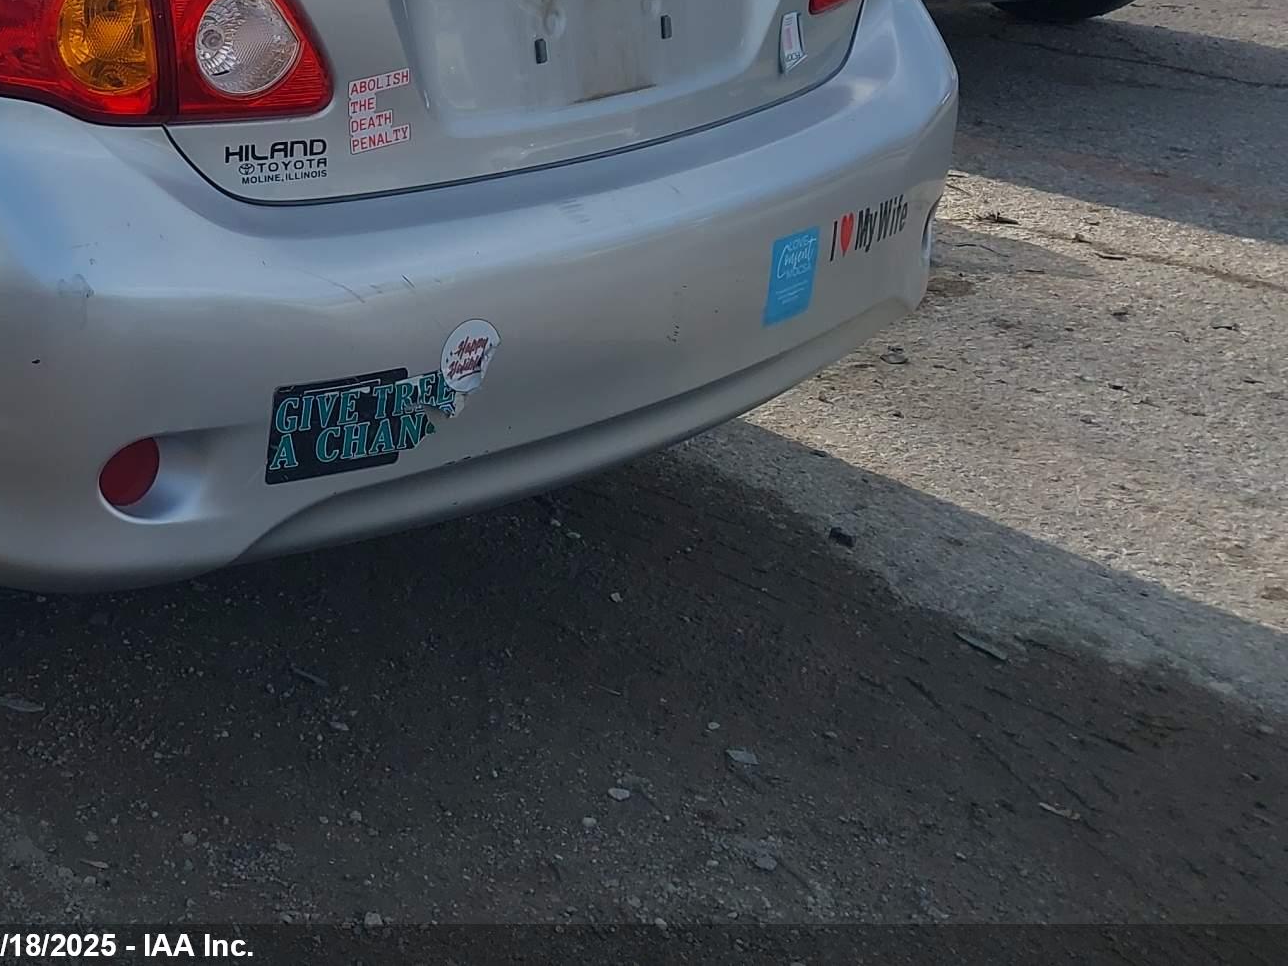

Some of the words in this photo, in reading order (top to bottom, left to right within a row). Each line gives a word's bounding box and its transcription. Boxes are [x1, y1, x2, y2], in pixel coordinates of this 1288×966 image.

[350, 70, 409, 96] ABOLISH
[350, 97, 376, 114] THE
[351, 112, 392, 133] DEATH
[225, 138, 327, 164] HILAND
[352, 126, 409, 153] PENALTY
[257, 158, 327, 173] TOYOTA
[829, 220, 838, 262] I
[854, 207, 878, 253] My
[876, 194, 908, 242] Wife
[454, 335, 489, 360] Happy
[275, 390, 360, 434] GIVE
[269, 433, 299, 470] A
